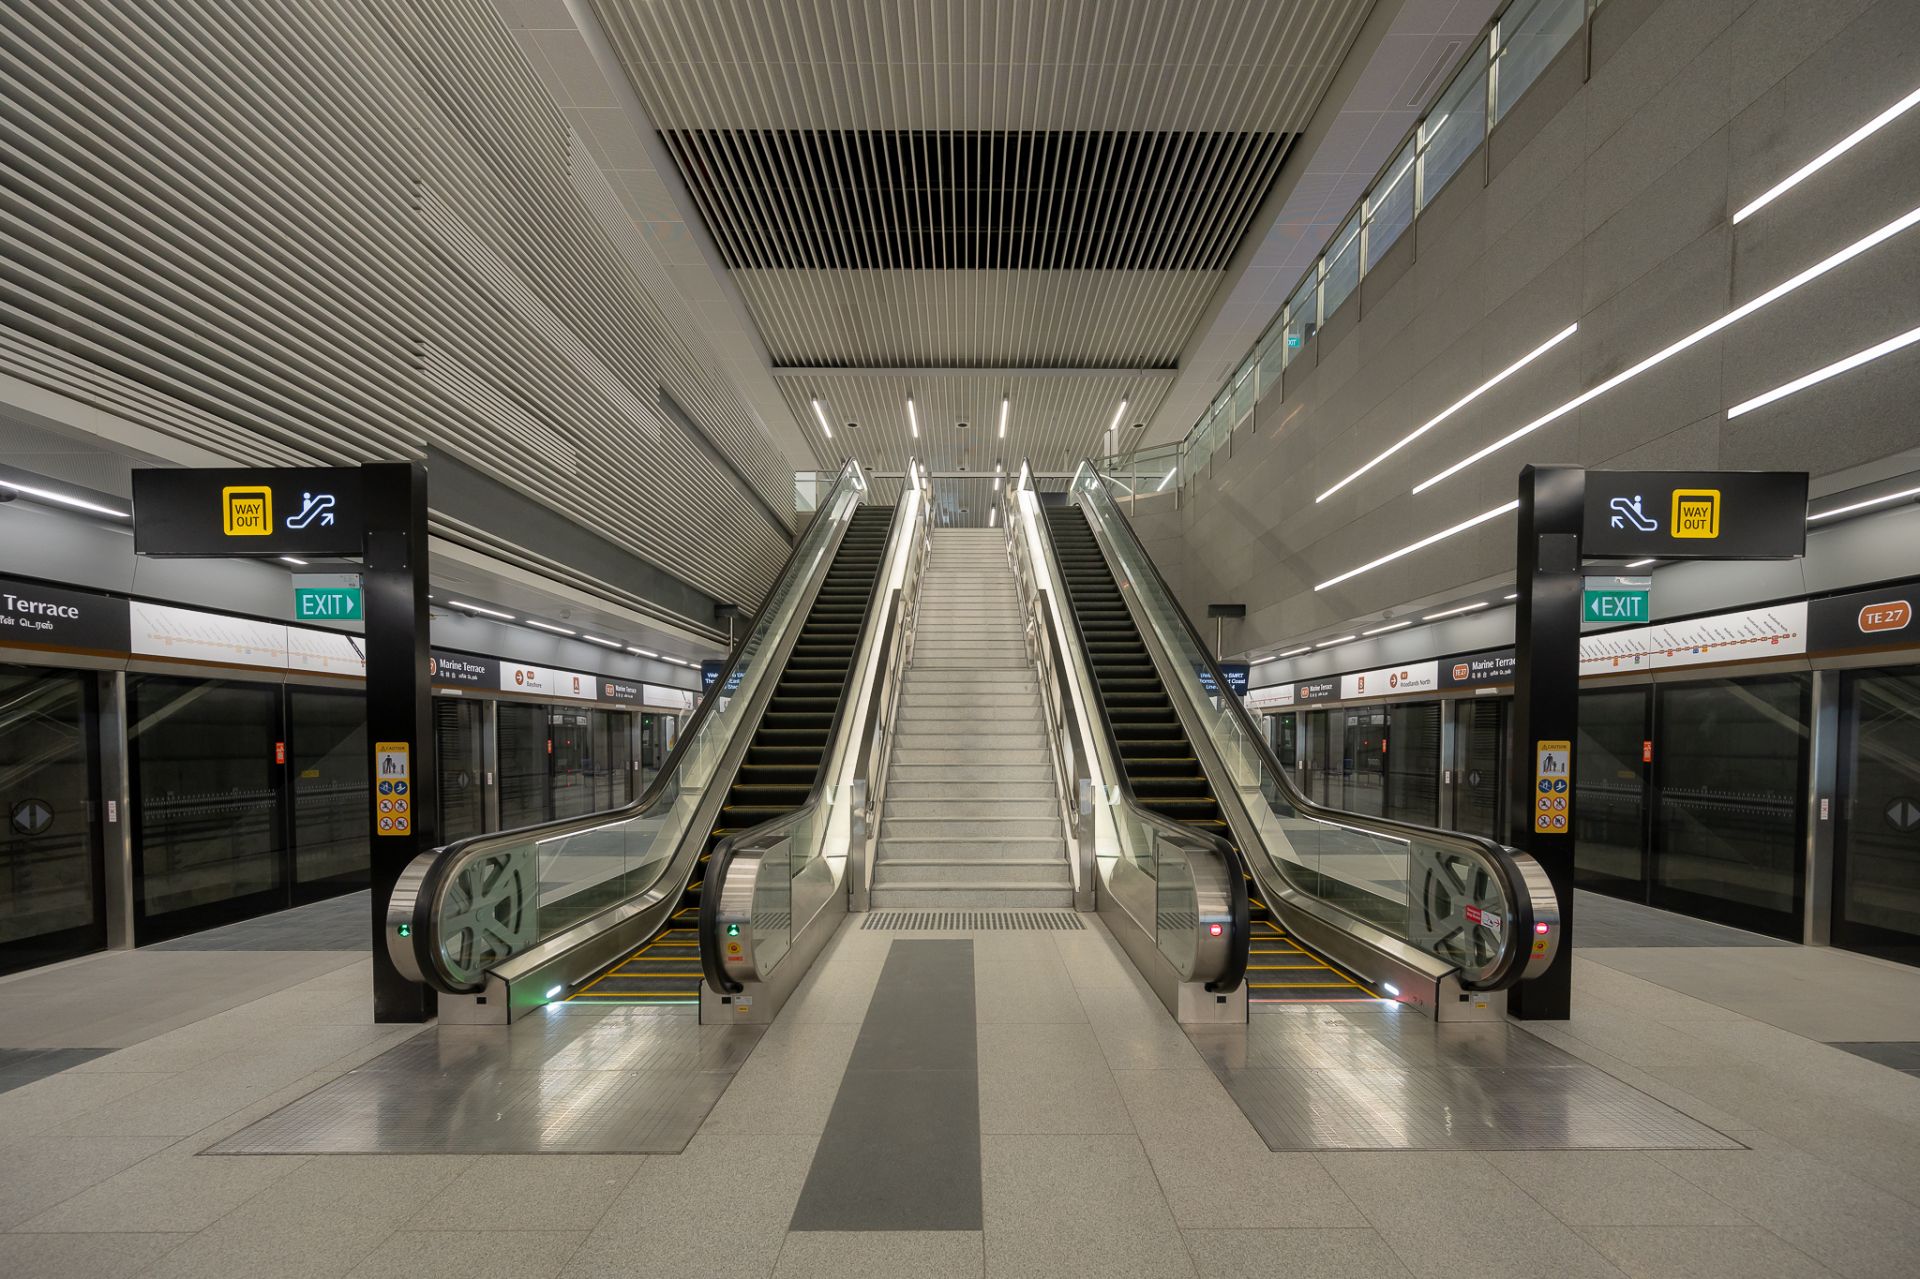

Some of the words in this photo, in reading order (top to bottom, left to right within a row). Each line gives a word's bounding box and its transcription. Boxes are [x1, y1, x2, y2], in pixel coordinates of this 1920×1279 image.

[235, 504, 260, 514] WAY
[1684, 507, 1708, 517] WAY
[236, 516, 260, 527] OUT
[1684, 520, 1706, 530] OUT
[2, 594, 78, 619] Terrace
[302, 594, 342, 614] EXIT
[1602, 596, 1642, 616] EXIT
[440, 659, 462, 670] Marine
[463, 662, 485, 674] Terrace
[1472, 660, 1494, 670] Marine
